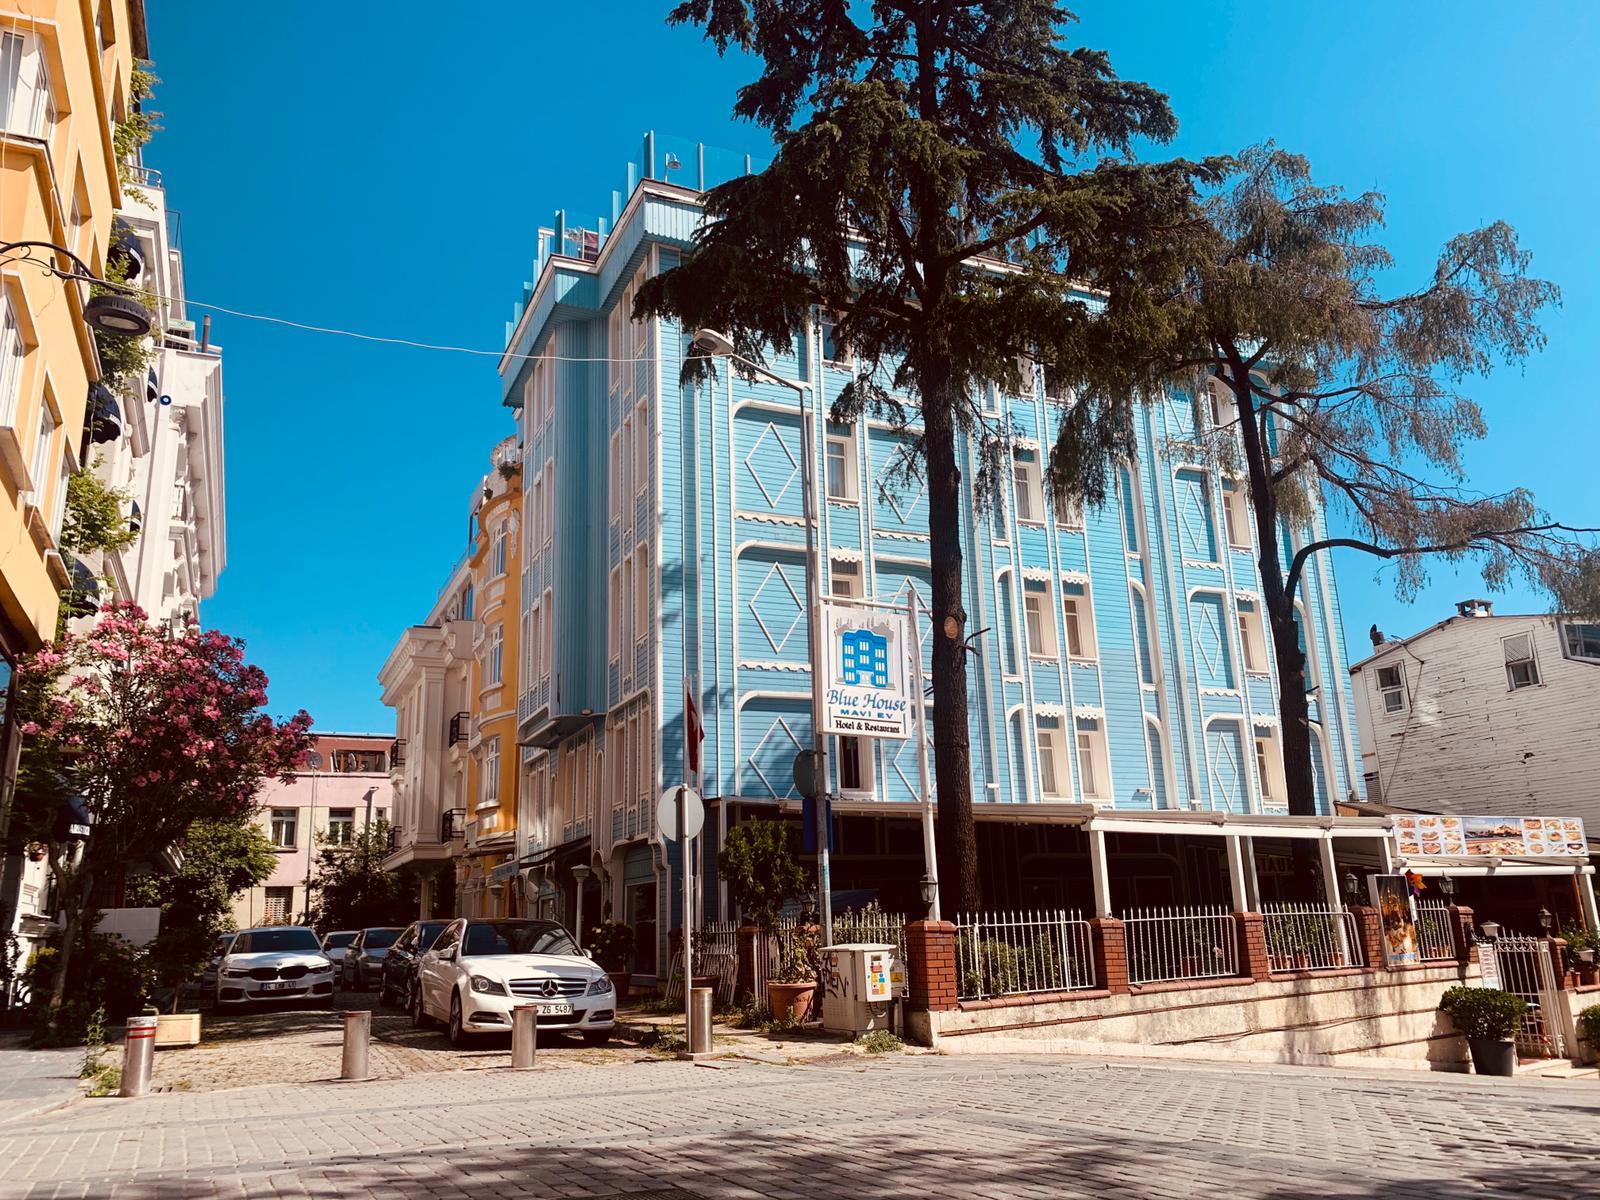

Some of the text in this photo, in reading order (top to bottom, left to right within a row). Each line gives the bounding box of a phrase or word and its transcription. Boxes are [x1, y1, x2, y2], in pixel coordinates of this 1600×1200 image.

[826, 689, 906, 711] Blue House
[840, 709, 871, 717] MAVI
[835, 720, 900, 733] Hotel & Restaurant
